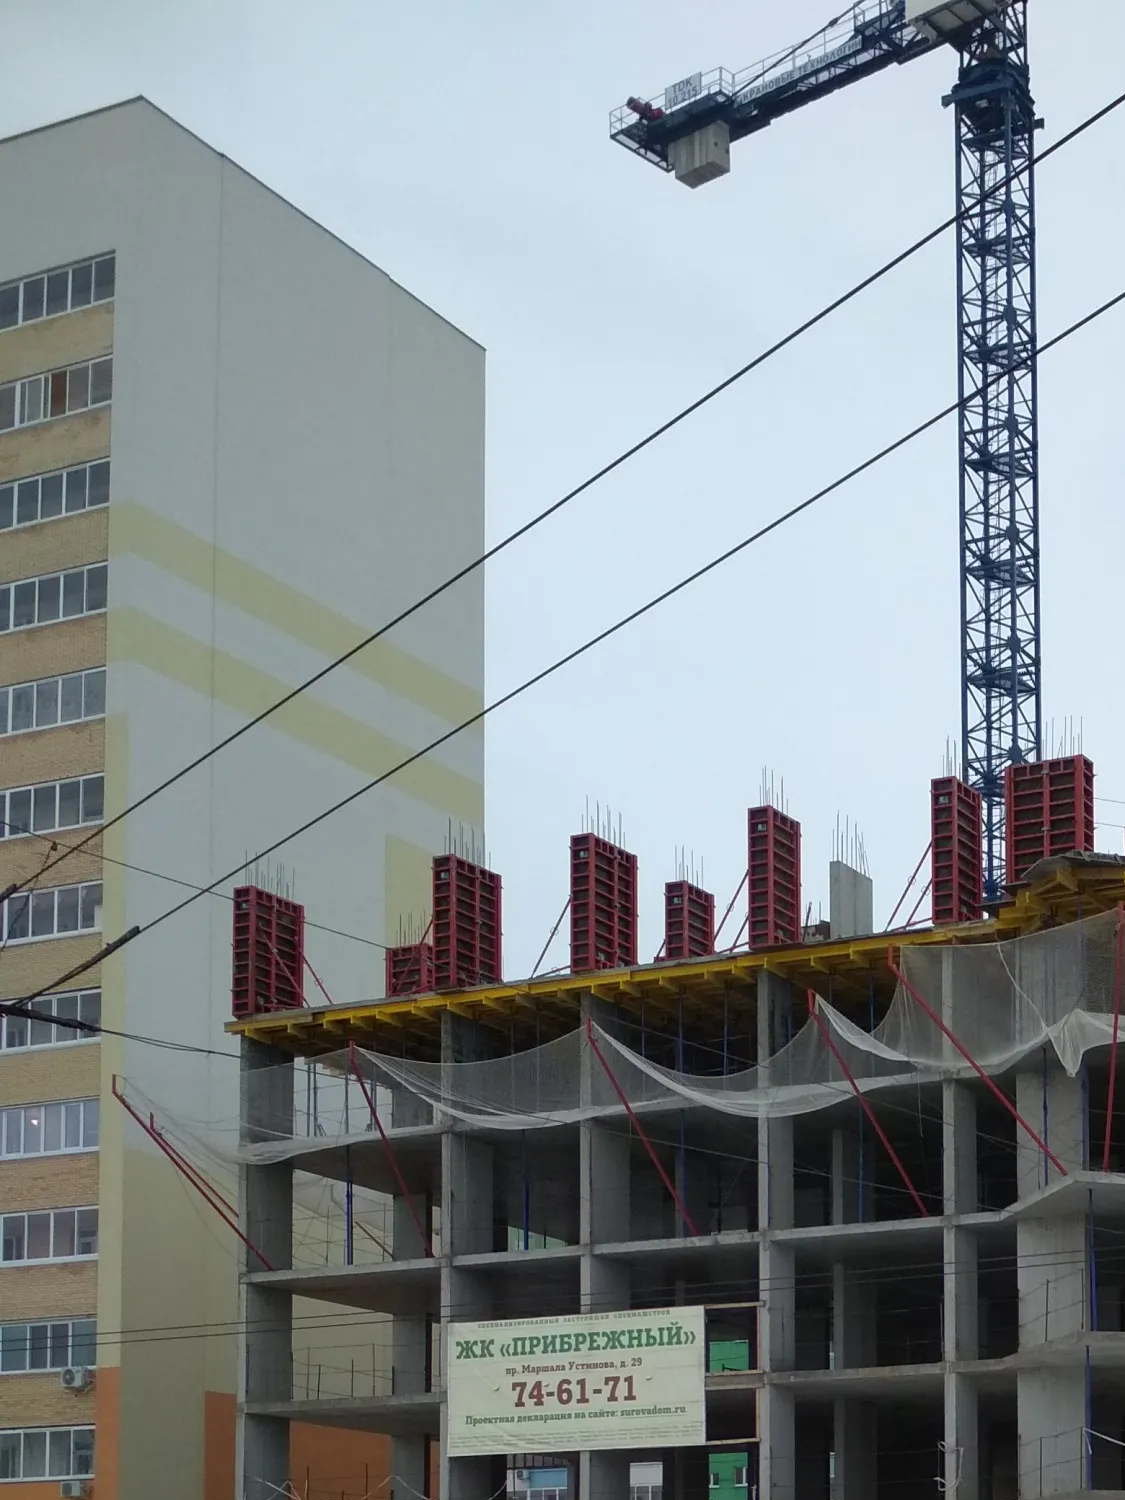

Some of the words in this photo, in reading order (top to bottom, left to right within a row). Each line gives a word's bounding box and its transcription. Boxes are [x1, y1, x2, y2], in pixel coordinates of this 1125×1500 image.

[743, 70, 796, 101] КРАНОВЫЕ
[798, 39, 861, 76] ТЕХНОЛОГИИ
[456, 1339, 495, 1360] ЖК
[500, 1321, 697, 1357] «ПРИБРЕЖНЫЙ»
[506, 1368, 520, 1377] пр.
[521, 1364, 566, 1375] Маршала
[568, 1361, 618, 1372] Устинова,
[620, 1361, 630, 1369] д.
[631, 1357, 643, 1367] 29
[512, 1375, 637, 1408] 74-61-71
[465, 1415, 515, 1427] Проектная
[517, 1413, 572, 1424] декларация
[574, 1412, 587, 1420] на
[588, 1409, 619, 1419] сайте:
[620, 1405, 687, 1418] surovadom.ru
